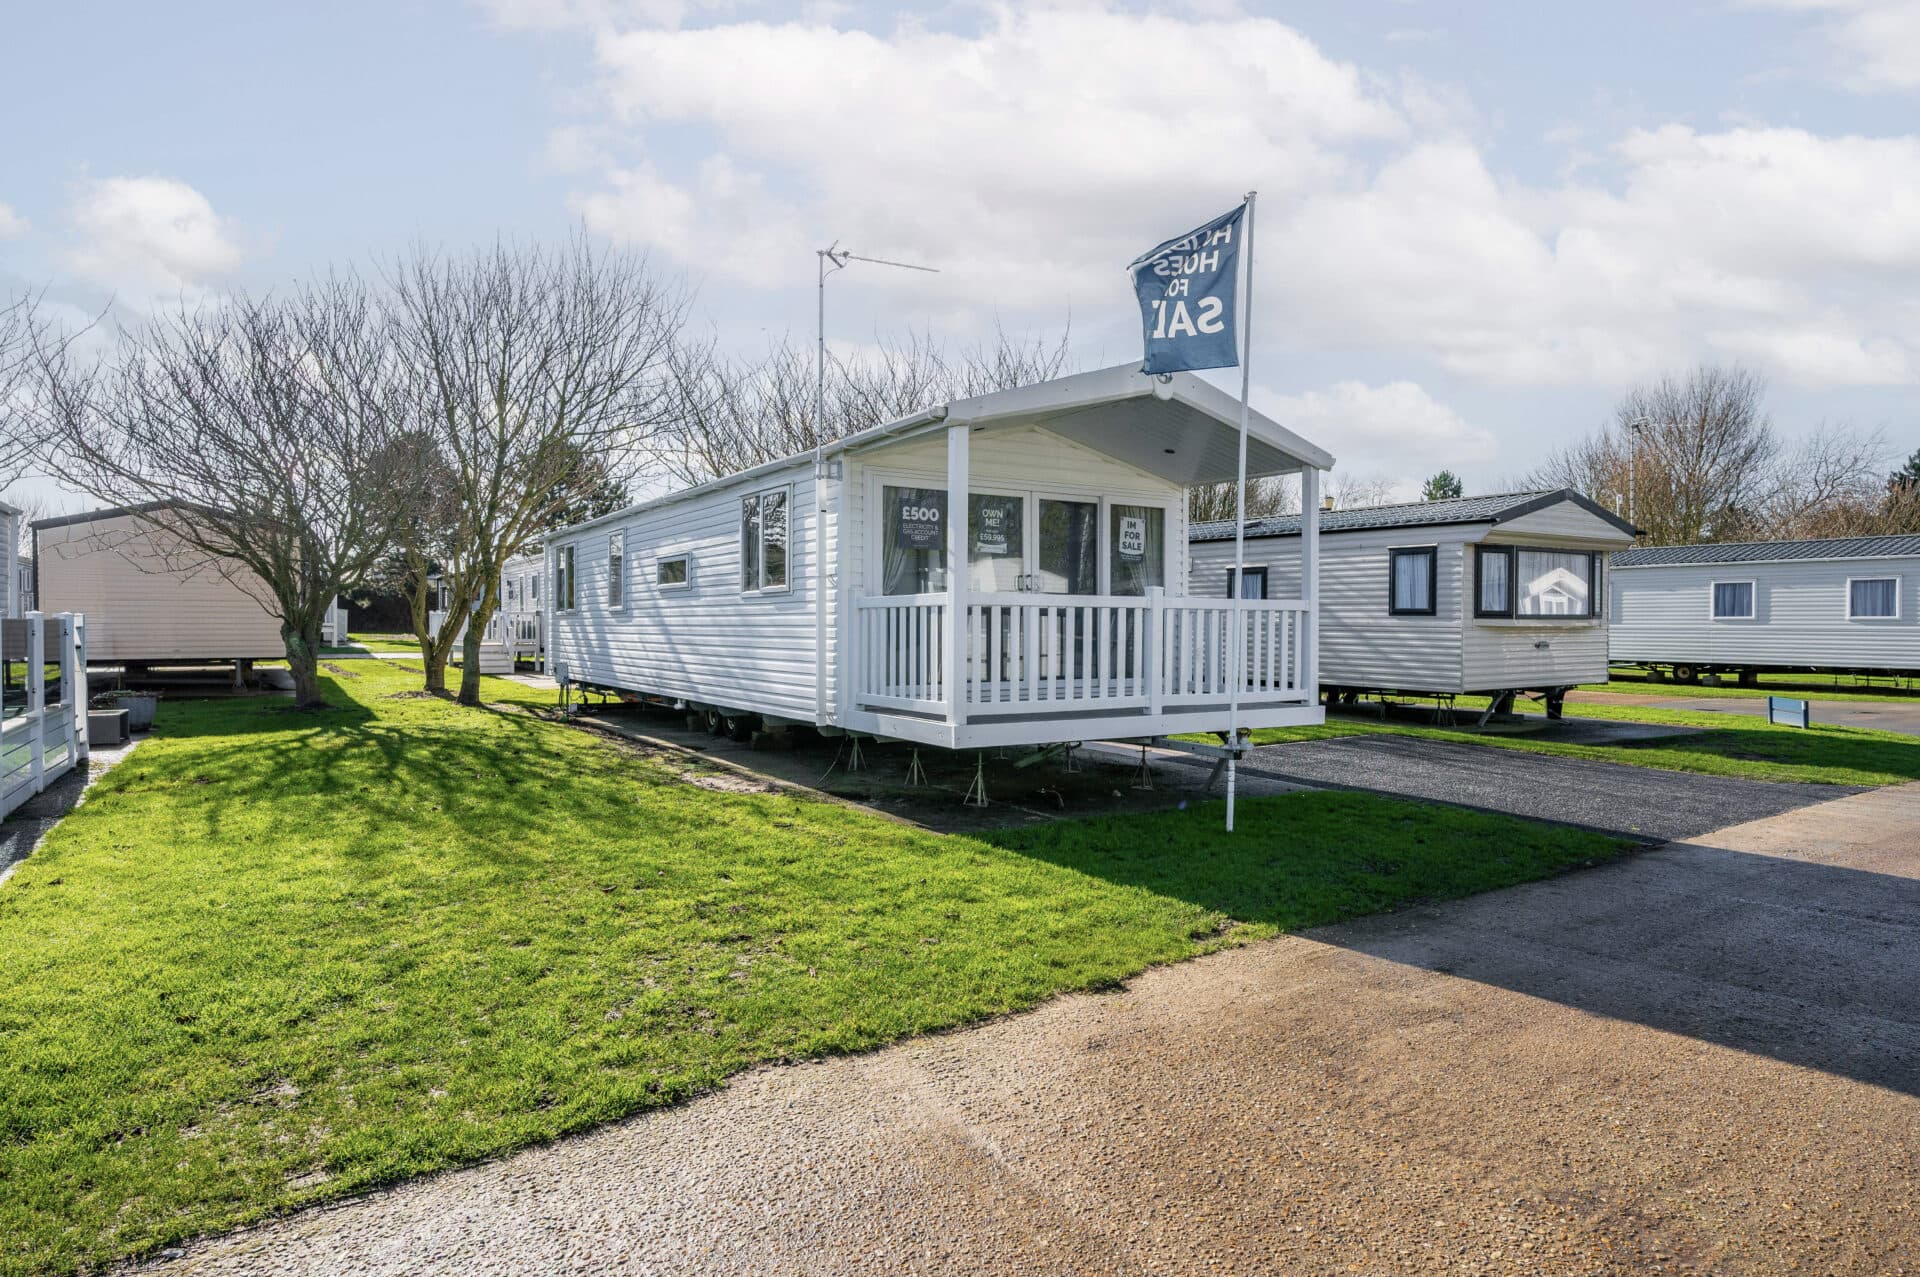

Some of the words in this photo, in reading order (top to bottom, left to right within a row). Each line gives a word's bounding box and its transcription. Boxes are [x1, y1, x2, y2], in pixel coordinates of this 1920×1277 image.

[902, 506, 939, 521] £500
[982, 509, 1003, 518] OWN
[1124, 531, 1140, 540] FOR
[1122, 541, 1142, 550] SALE
